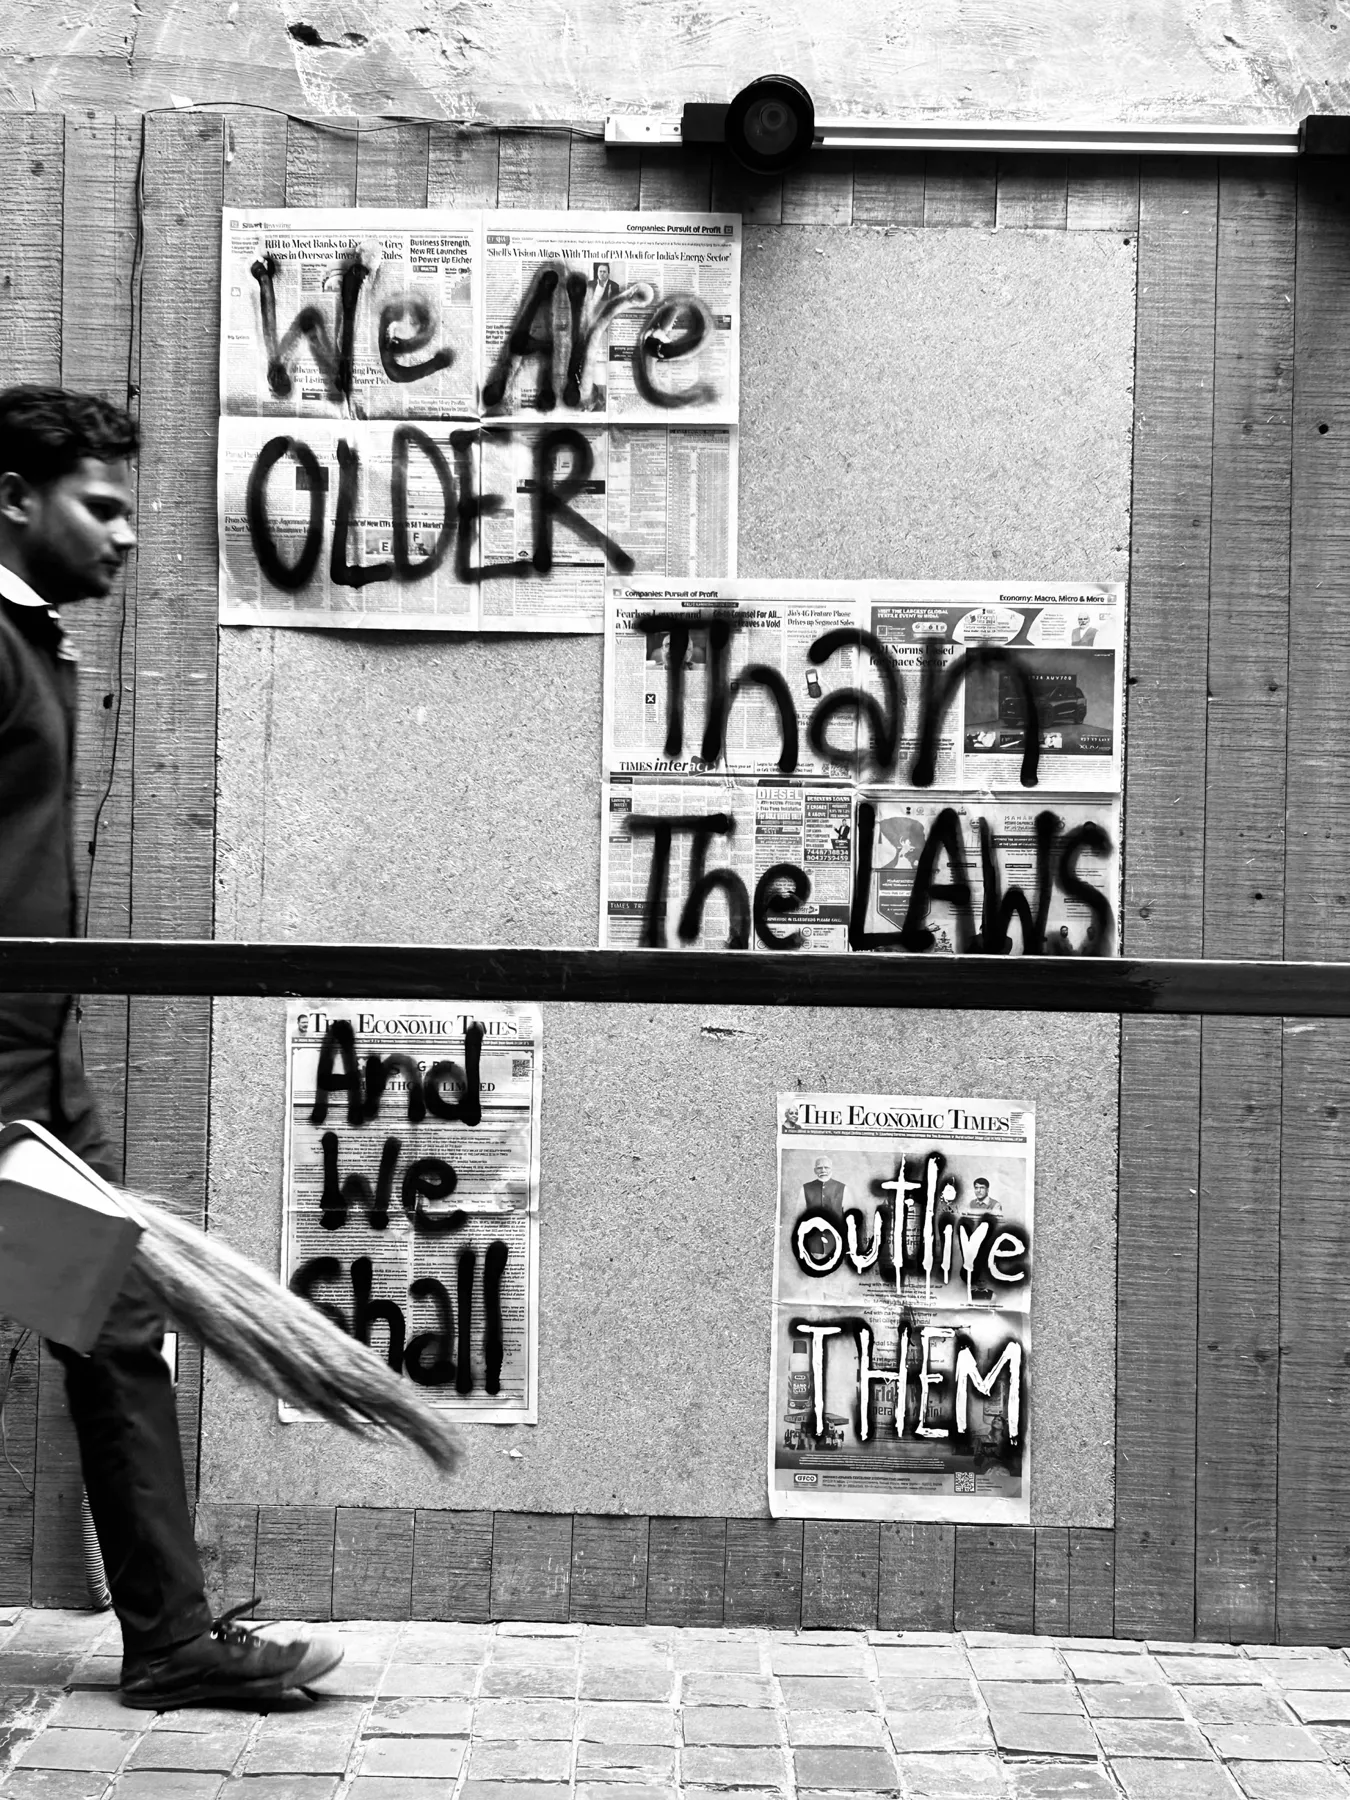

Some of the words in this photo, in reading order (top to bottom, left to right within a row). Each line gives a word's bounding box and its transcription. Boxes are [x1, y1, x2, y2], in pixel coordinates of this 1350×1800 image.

[626, 224, 665, 233] Companies:
[667, 225, 692, 233] Pursuit
[693, 225, 701, 233] of
[701, 226, 722, 234] Profit
[265, 239, 281, 249] RBI
[282, 240, 291, 249] to
[291, 239, 312, 249] Meet
[313, 239, 338, 249] Banks
[339, 240, 347, 249] to
[410, 239, 440, 247] Business
[289, 250, 297, 260] in
[297, 250, 334, 260] Overseas
[436, 248, 468, 256] Launches
[513, 248, 536, 257] Vision
[537, 248, 561, 259] Aligns
[561, 249, 581, 259] With
[581, 249, 600, 259] That
[601, 249, 611, 259] of
[611, 249, 623, 259] PM
[624, 250, 644, 260] Modi
[644, 250, 656, 260] for
[656, 250, 680, 261] India's
[680, 251, 706, 263] Energy
[410, 256, 417, 264] to
[418, 256, 440, 264] Power
[441, 256, 451, 265] Up
[451, 256, 473, 264] Eicher
[250, 254, 457, 402] We
[483, 266, 718, 411] Are
[247, 424, 635, 592] OLDER
[625, 590, 663, 598] Companies:
[664, 590, 689, 598] Pursuit
[690, 590, 698, 598] of
[698, 591, 719, 599] Profit
[999, 594, 1033, 603] Economy:
[1034, 594, 1058, 603] Macro,
[1058, 595, 1079, 603] Micro
[1079, 595, 1086, 603] &
[1086, 595, 1105, 603] More
[616, 608, 651, 619] Fearless
[756, 610, 768, 619] For
[766, 620, 781, 628] Void
[787, 618, 806, 627] Drives
[891, 644, 924, 655] Norms
[925, 644, 954, 655] Esed
[915, 656, 949, 668] Secor
[634, 613, 1041, 789] Than
[619, 761, 653, 771] TIMES
[757, 788, 801, 800] DIESEL
[622, 813, 811, 951] The
[356, 1013, 454, 1035] ECONOMIC
[457, 1014, 517, 1036] TMES
[310, 1019, 484, 1126] And
[442, 1081, 496, 1092] LIMED
[799, 1103, 843, 1126] THE
[846, 1105, 945, 1129] ECONOMIC
[947, 1108, 1010, 1132] TIMES
[320, 1132, 466, 1234] We
[793, 1152, 1028, 1288] outlive
[790, 1319, 1024, 1446] THEM
